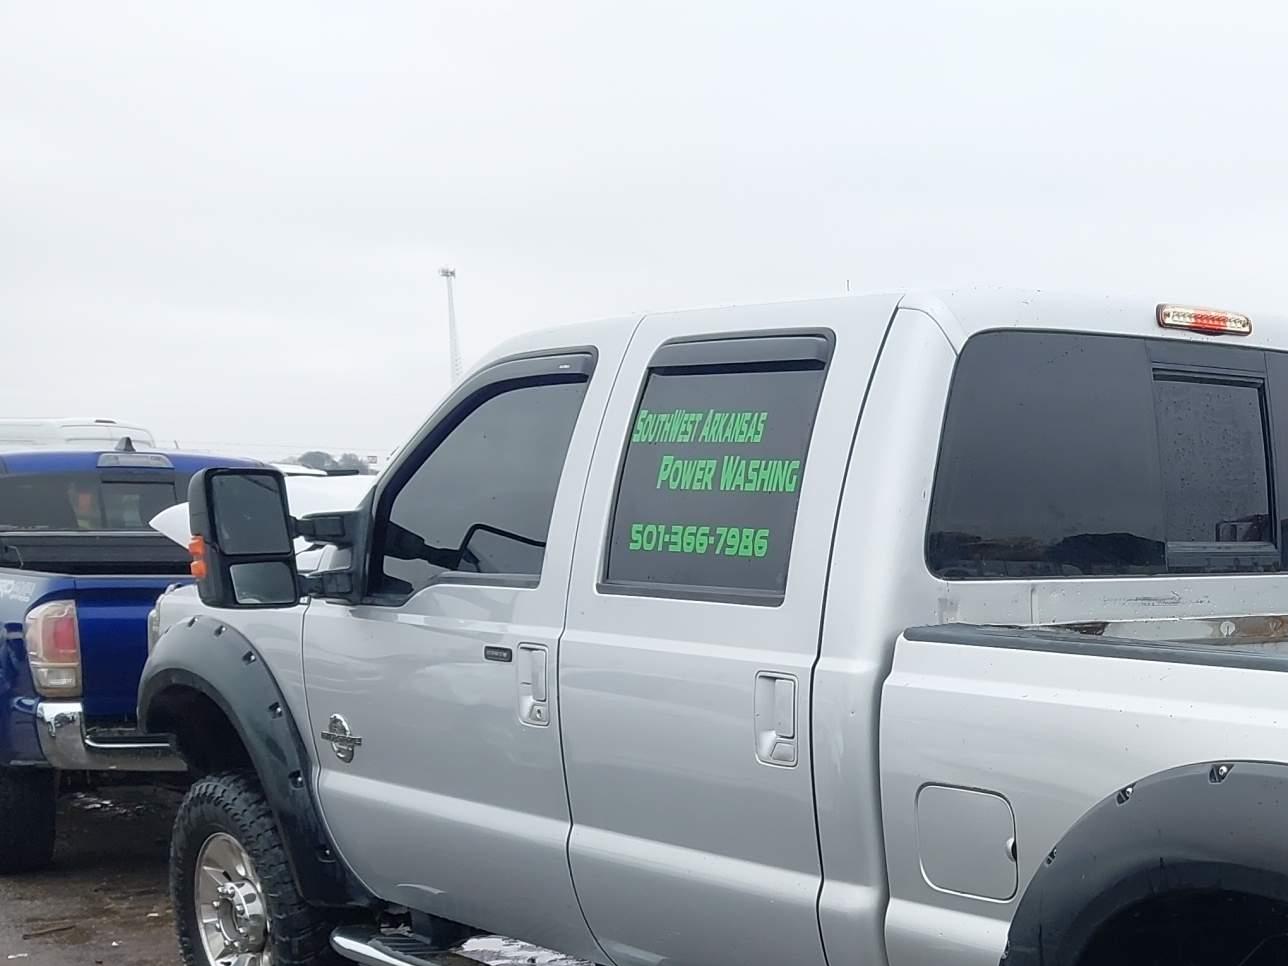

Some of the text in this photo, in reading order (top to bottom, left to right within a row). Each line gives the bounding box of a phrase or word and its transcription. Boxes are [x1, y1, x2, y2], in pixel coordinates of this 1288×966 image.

[698, 409, 769, 443] ARKANSAS
[656, 454, 800, 493] POWER WASHING
[628, 522, 771, 558] 501-366-7986
